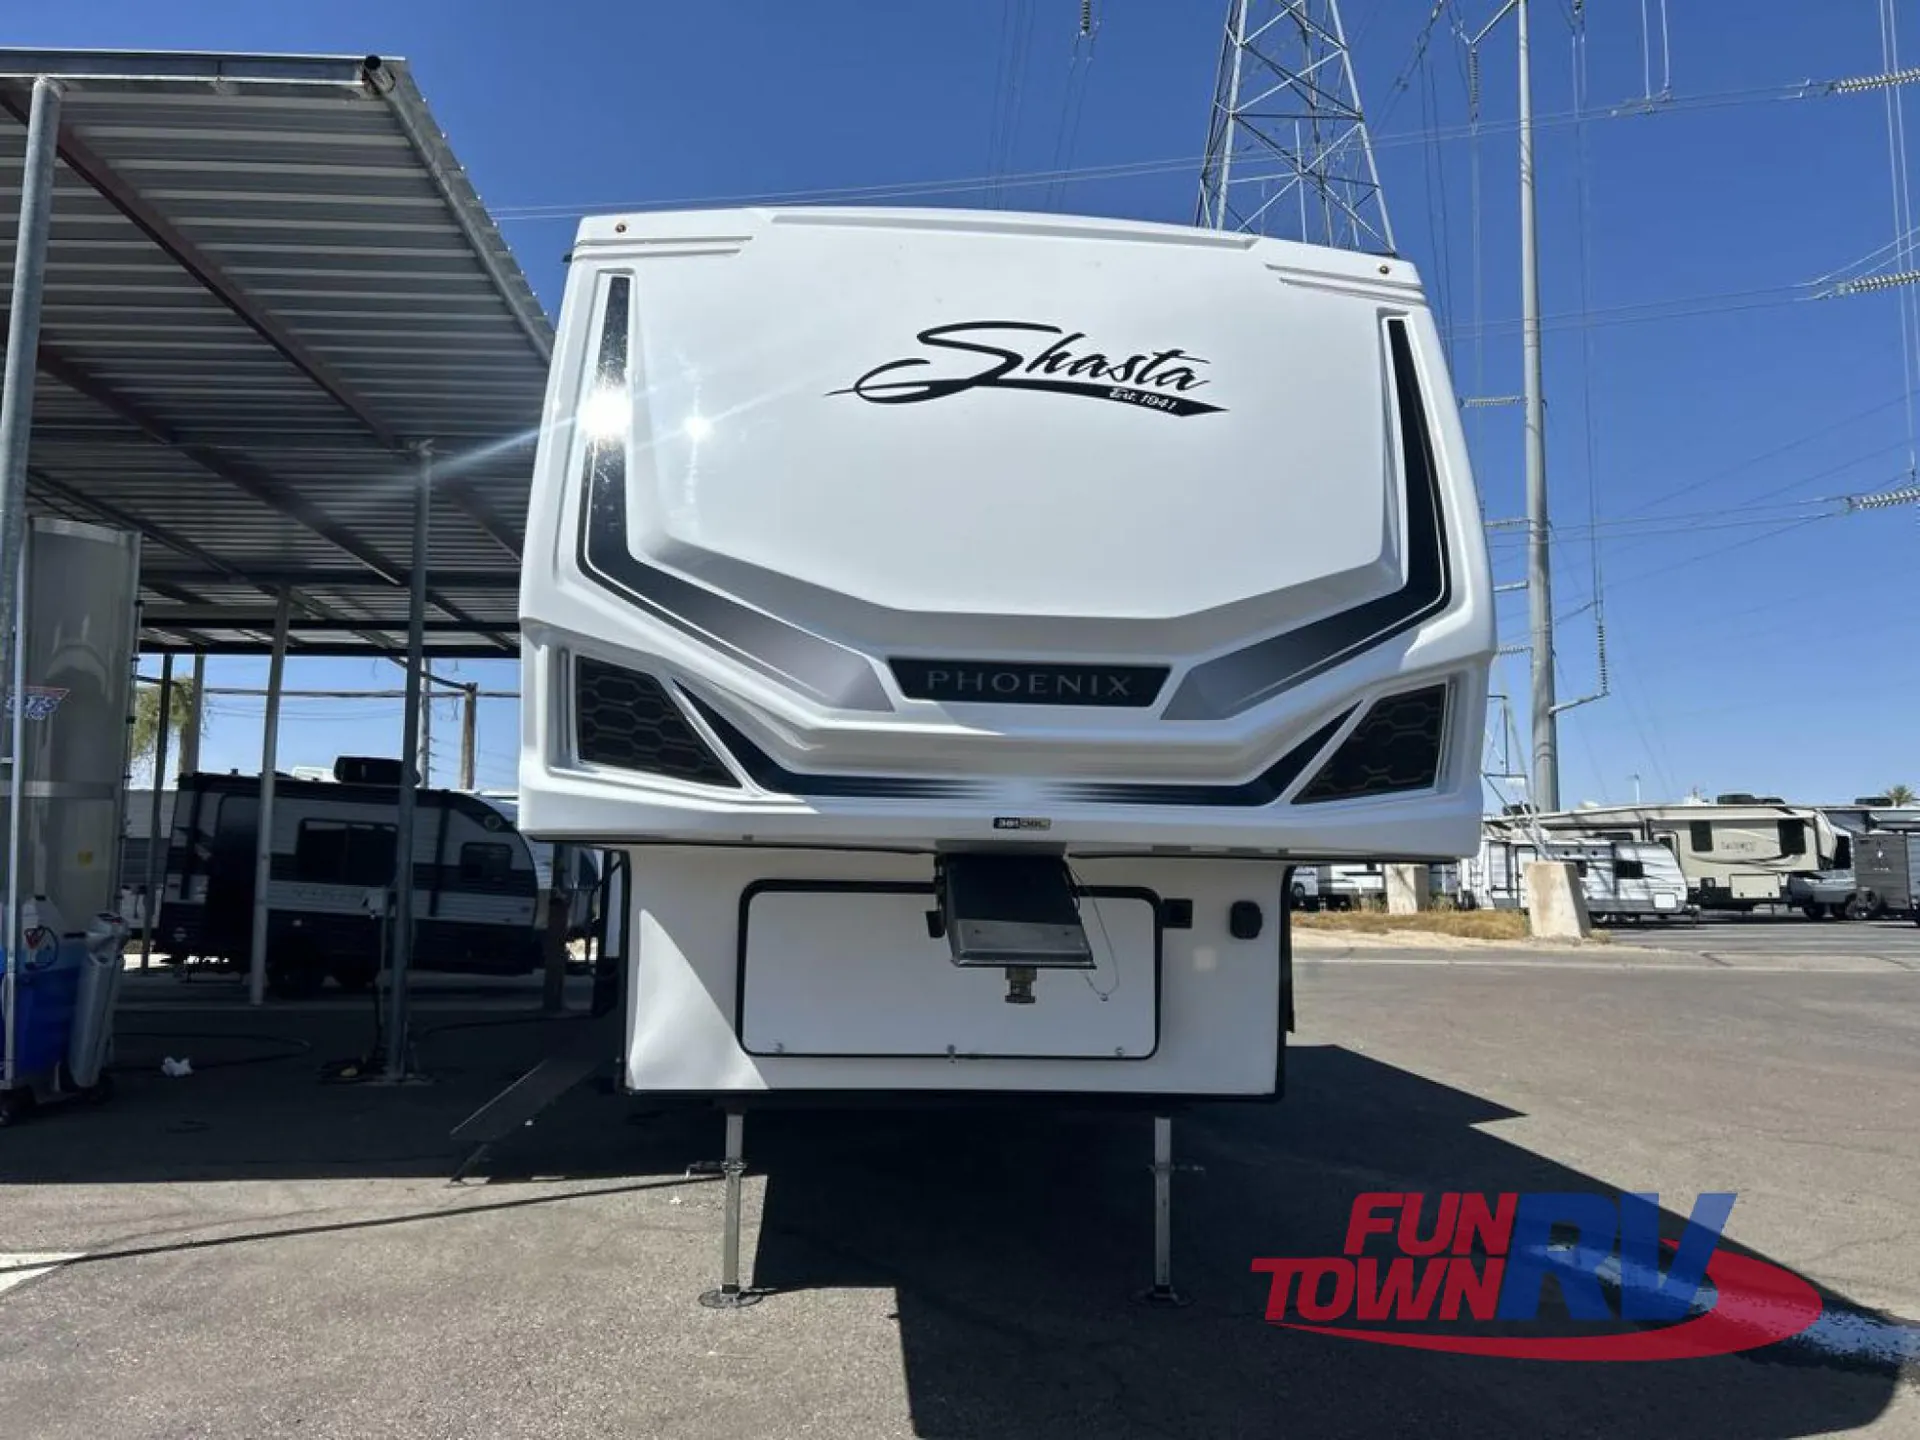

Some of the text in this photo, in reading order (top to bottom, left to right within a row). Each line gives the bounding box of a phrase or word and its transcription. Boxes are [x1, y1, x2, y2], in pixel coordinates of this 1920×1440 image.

[824, 320, 1214, 406] Shasta
[1140, 393, 1177, 411] 1941
[927, 670, 1132, 697] PHOENIX
